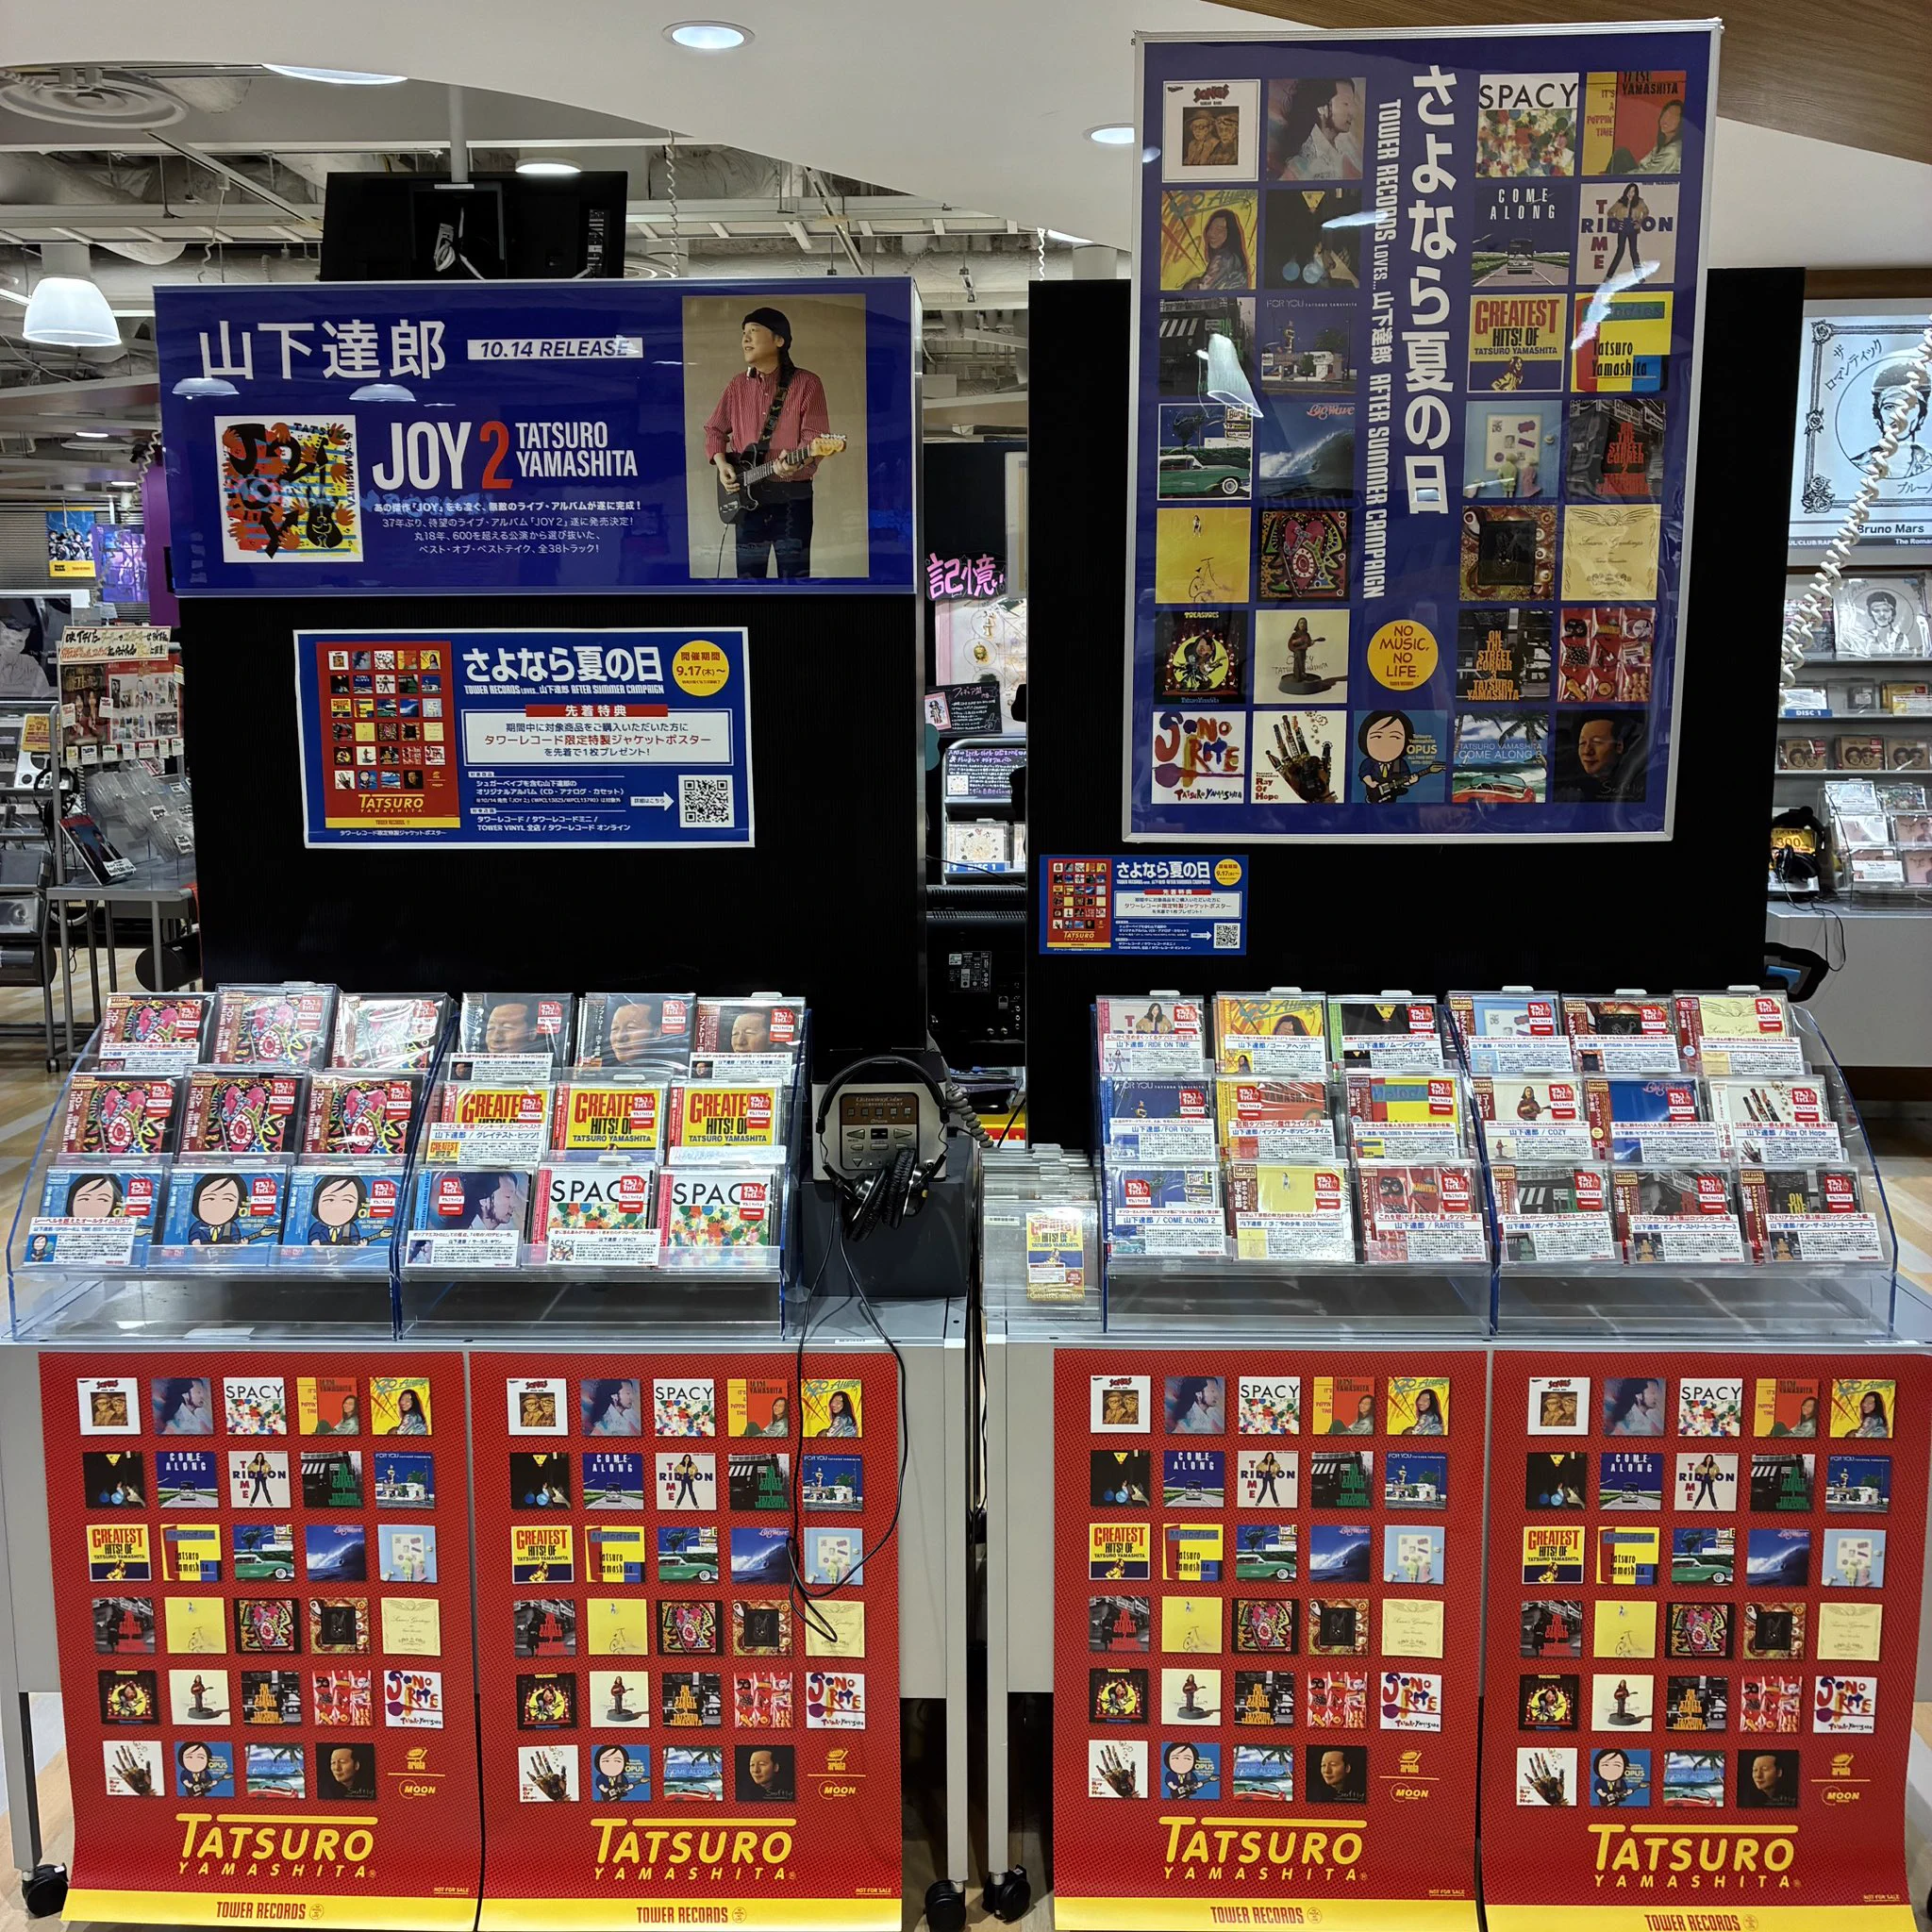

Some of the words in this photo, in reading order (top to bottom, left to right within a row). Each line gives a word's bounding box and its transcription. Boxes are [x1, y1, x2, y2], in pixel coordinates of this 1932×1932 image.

[1478, 82, 1579, 109] SPACY
[1623, 82, 1678, 96] YAMASHITA
[1376, 98, 1401, 160] TOWER
[1596, 127, 1613, 137] TIME
[1373, 161, 1400, 242] RECORDS
[1498, 188, 1548, 204] COME
[1490, 205, 1556, 220] ALONG
[1641, 216, 1674, 232] ON
[1402, 65, 1457, 516] さよなら夏の日
[1474, 299, 1559, 335] GREATEST
[1370, 291, 1392, 365] 山下達郎
[1492, 327, 1524, 347] HITS!
[1524, 327, 1540, 346] OF
[199, 319, 446, 380] 山下達郎
[479, 341, 536, 359] 10.14
[540, 340, 630, 358] RELEASE
[1474, 347, 1510, 356] TATSURO
[1512, 346, 1557, 355] YAMASHITA
[1592, 340, 1633, 356] Tatsuro
[1591, 358, 1647, 376] Yamashita
[1368, 374, 1391, 425] AFTER
[515, 422, 608, 450] TATSURO
[1608, 442, 1643, 453] STREET
[372, 421, 472, 491] JOY
[479, 421, 514, 490] 2
[516, 449, 639, 478] YAMASHITA
[1607, 453, 1644, 464] CORNER
[1365, 425, 1391, 505] SUMMER
[1857, 525, 1892, 534] Bruno
[1894, 524, 1925, 534] Mars
[1362, 507, 1388, 599] CAMPAIGN
[1393, 625, 1414, 637] NO
[1488, 630, 1502, 641] ON
[1379, 638, 1429, 651] MUSIC,
[1487, 641, 1503, 651] THE
[680, 651, 721, 661] 開催期間
[1392, 652, 1413, 664] NO
[1478, 651, 1511, 661] STREET
[462, 645, 664, 683] さよなら夏の日
[1386, 665, 1419, 678] LIFE.
[1476, 660, 1512, 671] CORNER
[464, 685, 489, 695] TOWER
[490, 685, 521, 694] RECORDS
[572, 685, 592, 694] AFTER
[593, 685, 625, 694] SUMMER
[626, 684, 664, 694] CAMPAIGN
[1474, 679, 1513, 691] TATSURO
[1467, 690, 1520, 701] YAMASHITA
[565, 705, 627, 717] 先着特典
[484, 734, 712, 745] タワーレコード限定特製ジャケットポスター
[1406, 743, 1438, 756] OPUS
[1458, 751, 1491, 759] COME
[1493, 751, 1533, 759] ALONG
[1256, 777, 1274, 787] Ray
[358, 794, 425, 808] TATSURO
[1256, 793, 1279, 802] Hope
[1116, 860, 1211, 879] さよなら夏の日
[1063, 930, 1095, 940] TATSURO
[461, 1092, 520, 1124] GREATE
[575, 1092, 632, 1124] GREATE
[690, 1092, 748, 1124] GREATE
[591, 1118, 618, 1135] HITS!
[706, 1118, 734, 1135] HITS!
[550, 1179, 648, 1203] SPAC
[673, 1182, 769, 1206] SPAC
[225, 1385, 284, 1399] SPACY
[655, 1387, 713, 1401] SPACY
[1240, 1385, 1299, 1399] SPACY
[1681, 1386, 1741, 1401] SPACY
[169, 1453, 201, 1462] COME
[595, 1454, 628, 1464] COME
[1177, 1452, 1210, 1462] COME
[1615, 1454, 1648, 1463] COME
[165, 1461, 207, 1472] ALONG
[592, 1463, 633, 1473] ALONG
[1174, 1461, 1215, 1472] ALONG
[1610, 1462, 1653, 1473] ALONG
[92, 1528, 143, 1548] GREATEST
[516, 1529, 568, 1550] GREATEST
[1093, 1526, 1146, 1548] GREATEST
[1527, 1530, 1579, 1551] GREATEST
[405, 1785, 437, 1795] MOON
[824, 1786, 857, 1795] MOON
[1395, 1789, 1429, 1799] MOON
[1826, 1791, 1859, 1801] MOON
[175, 1813, 378, 1861] TATSURO
[591, 1818, 797, 1865] TATSURO
[1158, 1816, 1368, 1866] TATSURO
[1588, 1824, 1799, 1872] TATSURO
[178, 1862, 368, 1878] YAMASHITA
[594, 1867, 786, 1881] YAMASHITA
[1163, 1866, 1357, 1881] YAMASHITA
[1594, 1874, 1790, 1888] YAMASHITA
[216, 1902, 254, 1919] TOWER
[256, 1902, 307, 1921] RECORDS
[637, 1907, 675, 1924] TOWER
[677, 1907, 728, 1924] RECORDS
[1210, 1907, 1251, 1924] TOWER
[1253, 1907, 1305, 1925] RECORDS
[1644, 1914, 1686, 1931] TOWER
[1688, 1914, 1740, 1932] RECORDS
